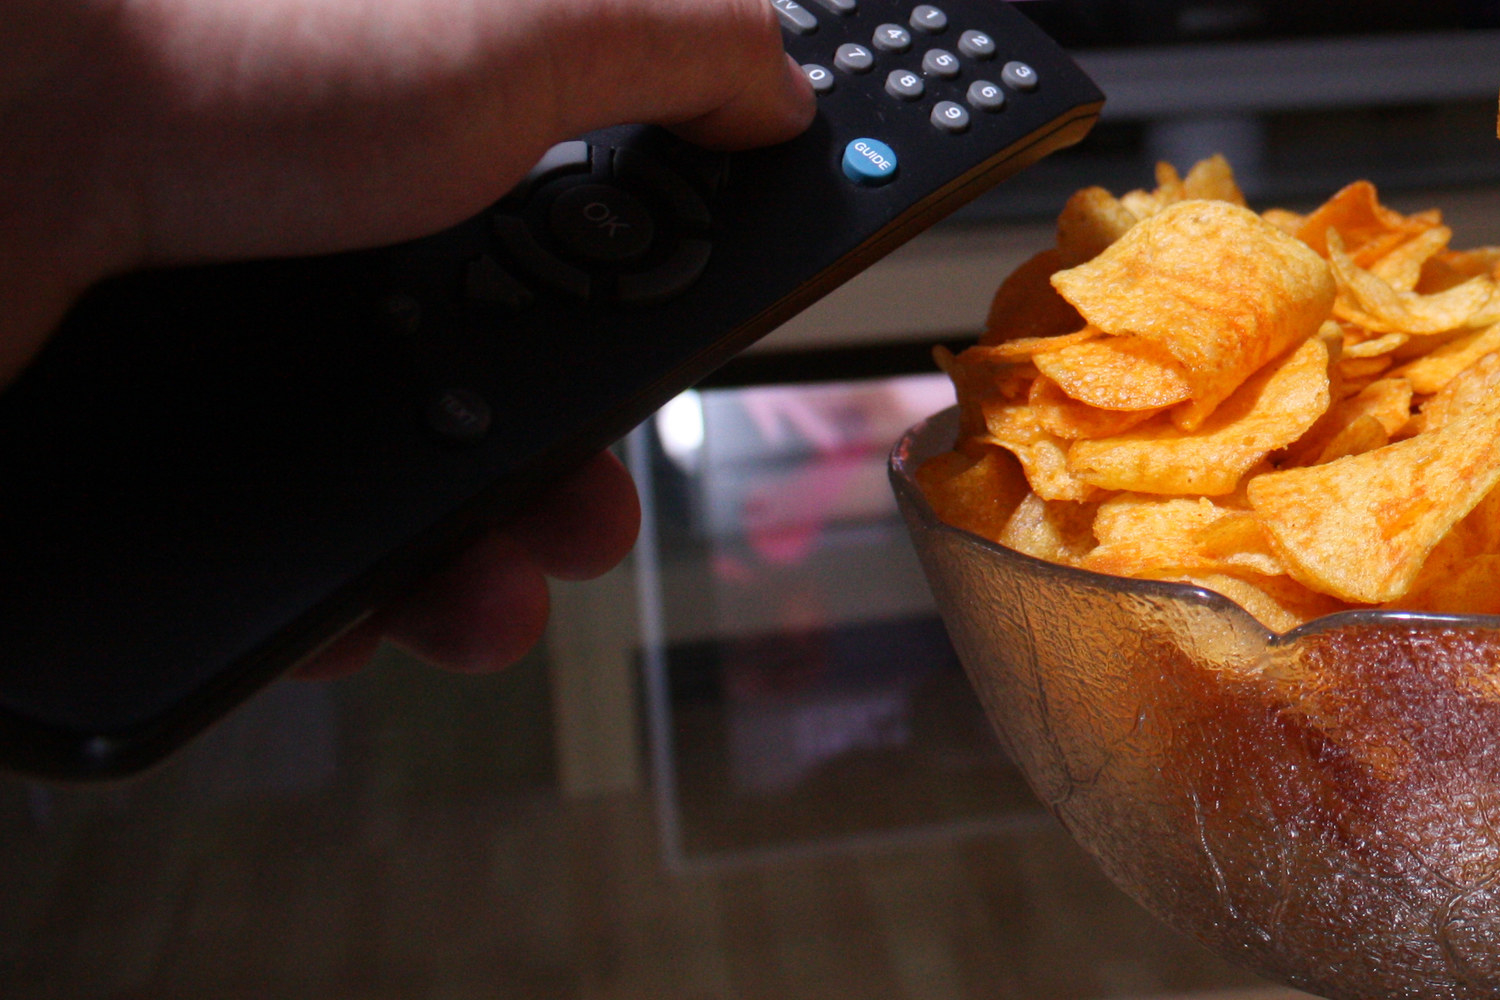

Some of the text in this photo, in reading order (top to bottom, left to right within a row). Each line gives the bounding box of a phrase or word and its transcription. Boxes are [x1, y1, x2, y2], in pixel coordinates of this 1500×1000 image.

[926, 10, 939, 19] 1
[887, 29, 902, 39] 4
[971, 35, 989, 47] 2
[848, 47, 866, 58] 7
[936, 54, 953, 66] 5
[809, 68, 826, 80] 0
[1015, 66, 1032, 78] 3
[900, 74, 917, 87] 8
[981, 86, 998, 98] 6
[945, 107, 962, 119] 9
[854, 142, 892, 171] GUIDE
[582, 201, 631, 239] OK
